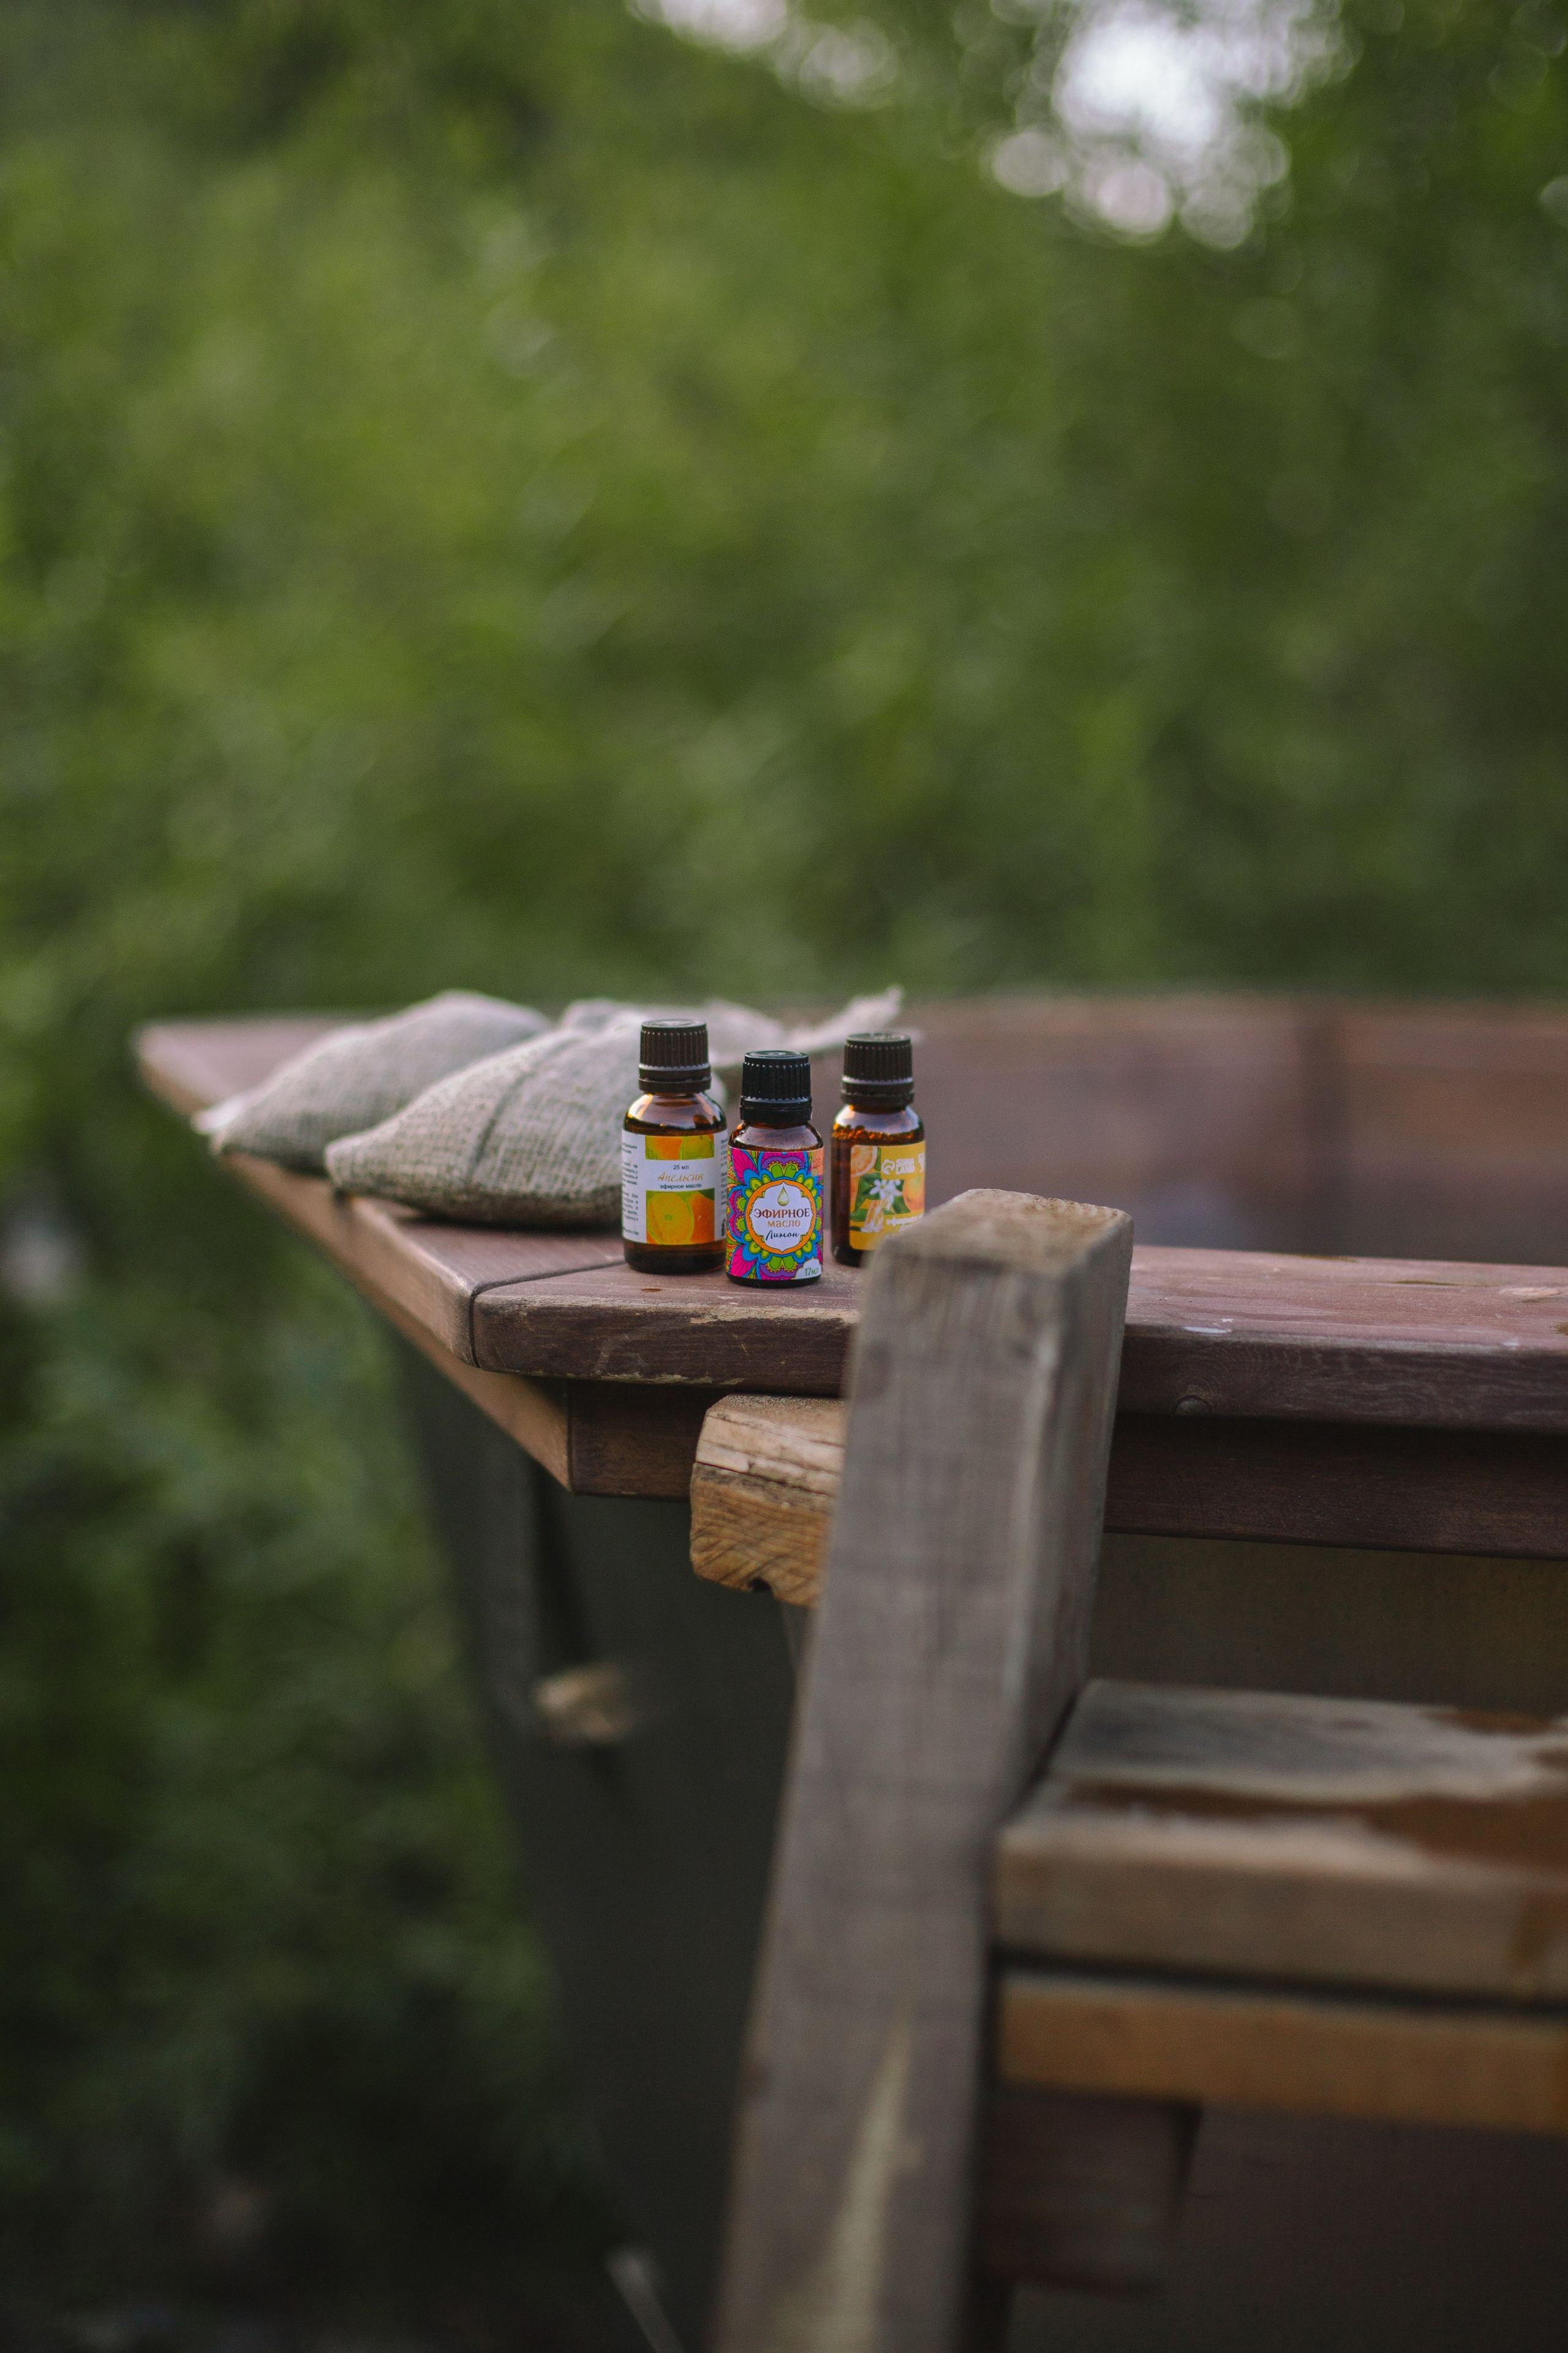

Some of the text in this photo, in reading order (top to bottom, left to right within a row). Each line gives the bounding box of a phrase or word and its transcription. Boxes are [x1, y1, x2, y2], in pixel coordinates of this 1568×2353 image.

[657, 1171, 704, 1182] Апельсин
[754, 1208, 810, 1218] ЭФИРНОЕ
[766, 1229, 799, 1241] Лимон
